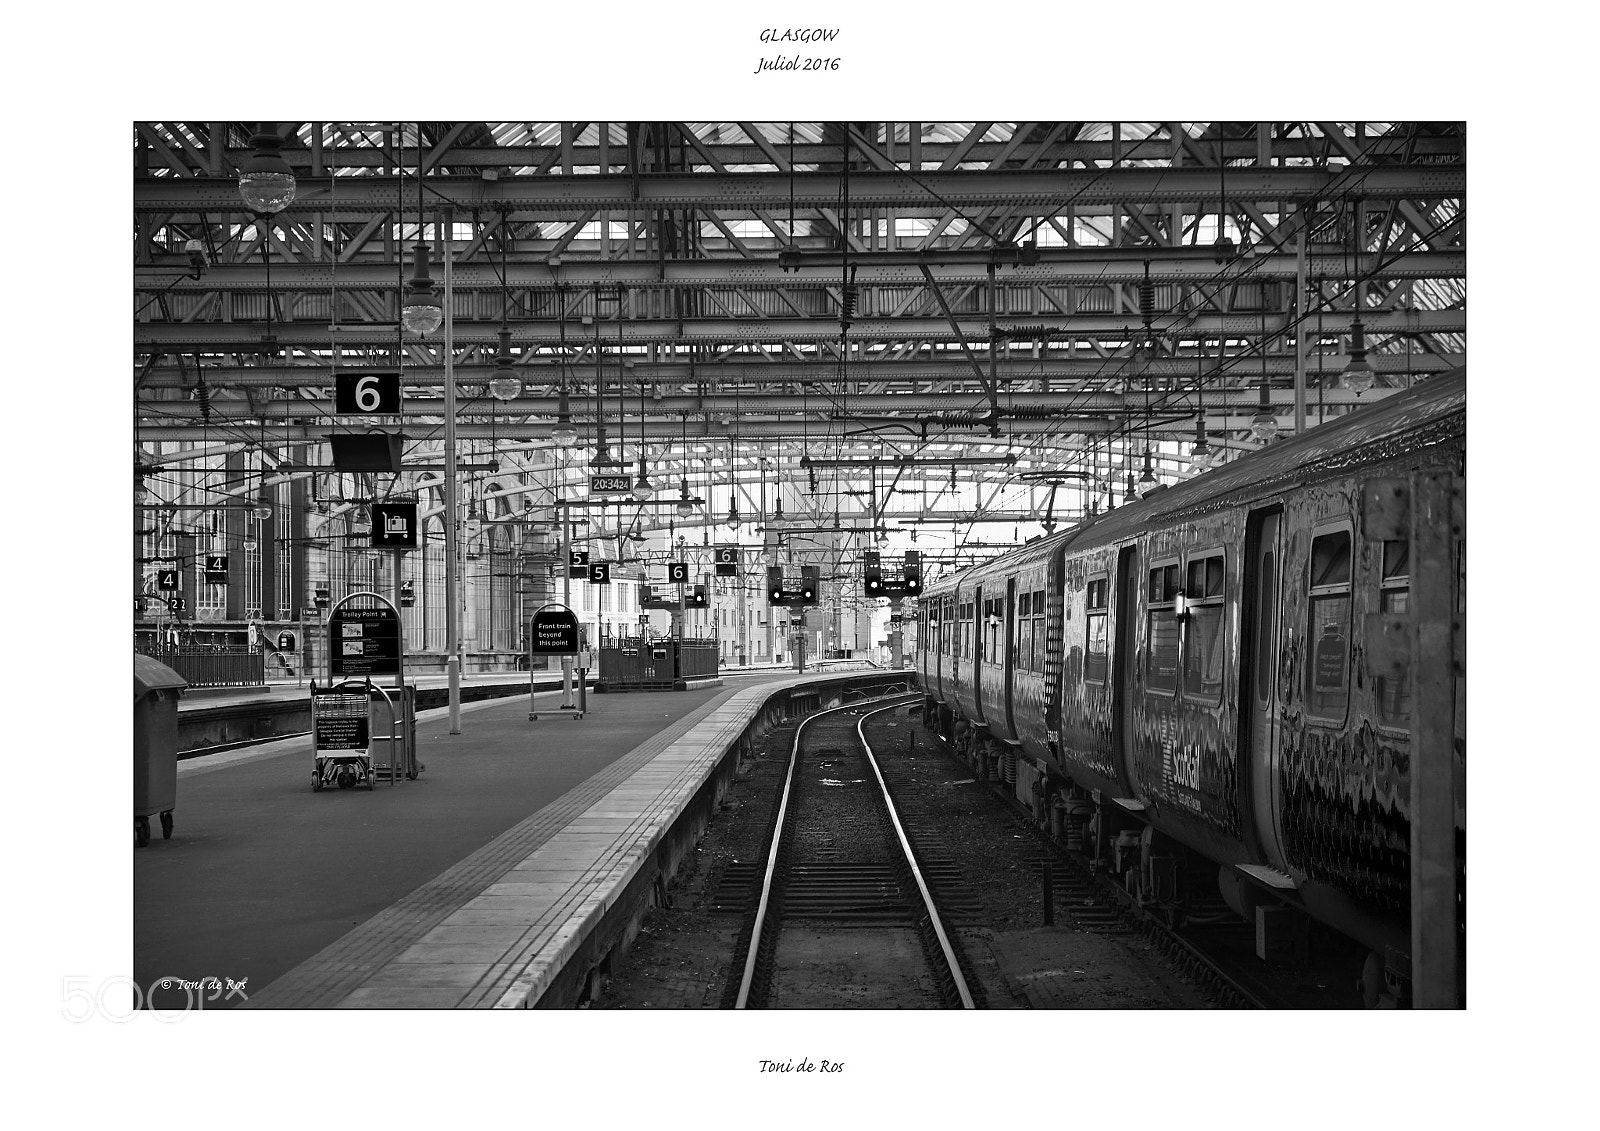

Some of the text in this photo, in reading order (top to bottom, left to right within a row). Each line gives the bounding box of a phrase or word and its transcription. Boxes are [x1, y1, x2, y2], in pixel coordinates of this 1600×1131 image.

[355, 376, 380, 412] 6
[573, 553, 582, 565] 5
[721, 549, 731, 562] 6
[212, 557, 223, 570] 4
[594, 567, 604, 580] 5
[673, 566, 683, 579] 6
[163, 573, 174, 587] 4
[171, 600, 178, 609] 2
[342, 611, 361, 619] Trolley
[538, 631, 562, 639] beyond
[1172, 740, 1200, 792] ScotRail
